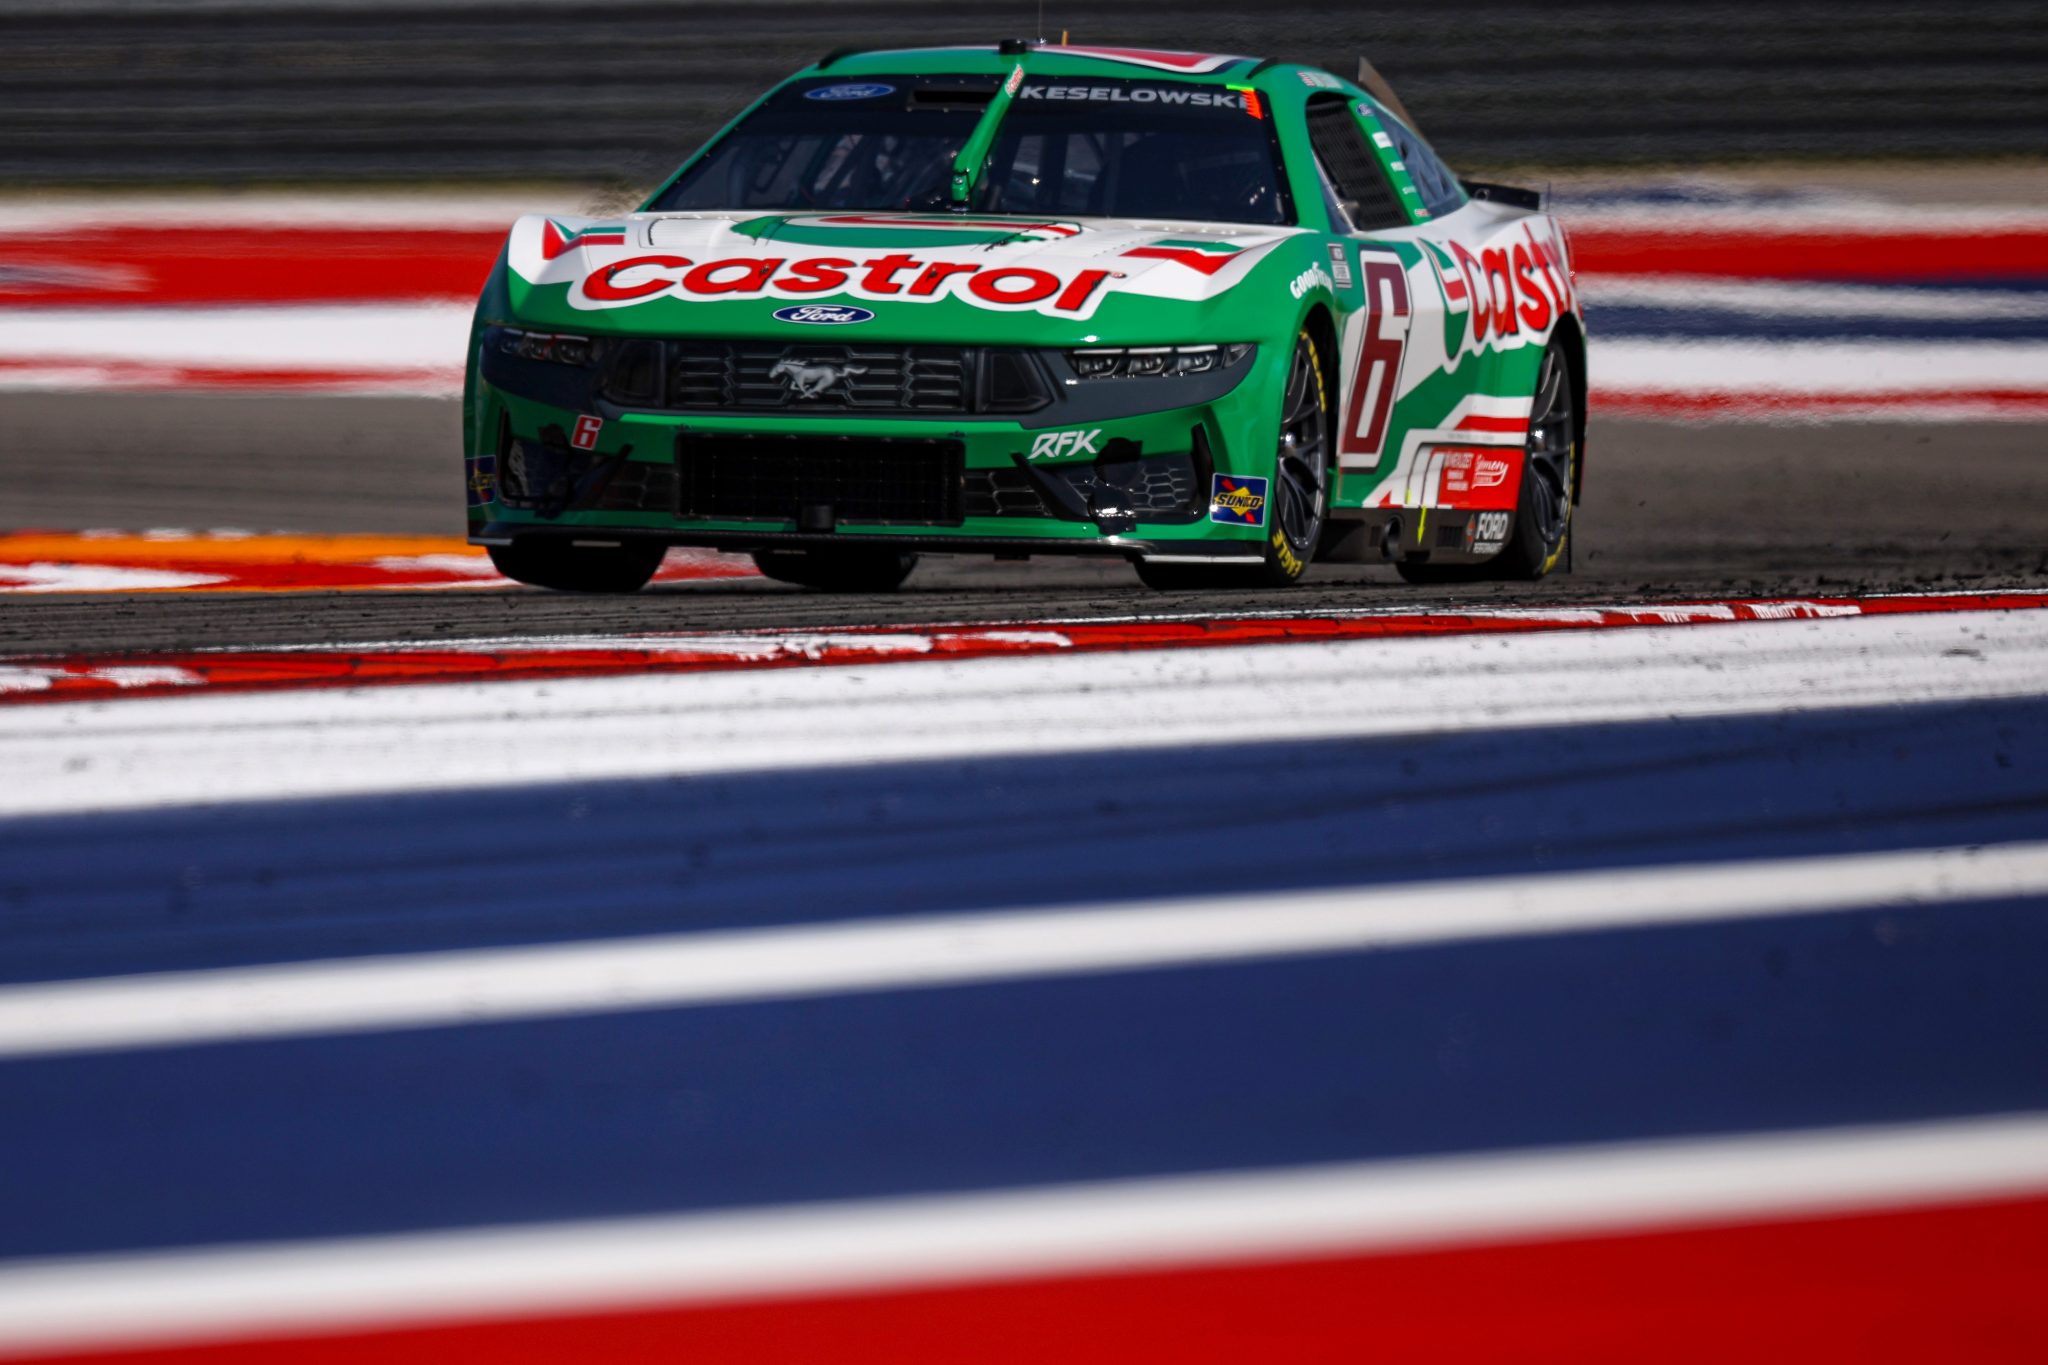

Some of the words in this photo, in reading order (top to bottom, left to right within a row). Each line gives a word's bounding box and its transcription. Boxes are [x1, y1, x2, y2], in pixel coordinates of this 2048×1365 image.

[583, 254, 1110, 312] Castrol
[790, 306, 856, 321] Ford
[1340, 258, 1411, 459] 6
[571, 415, 603, 450] 6
[1027, 429, 1102, 459] RFK
[1217, 493, 1261, 509] SUNOCO
[1475, 512, 1509, 540] FORD
